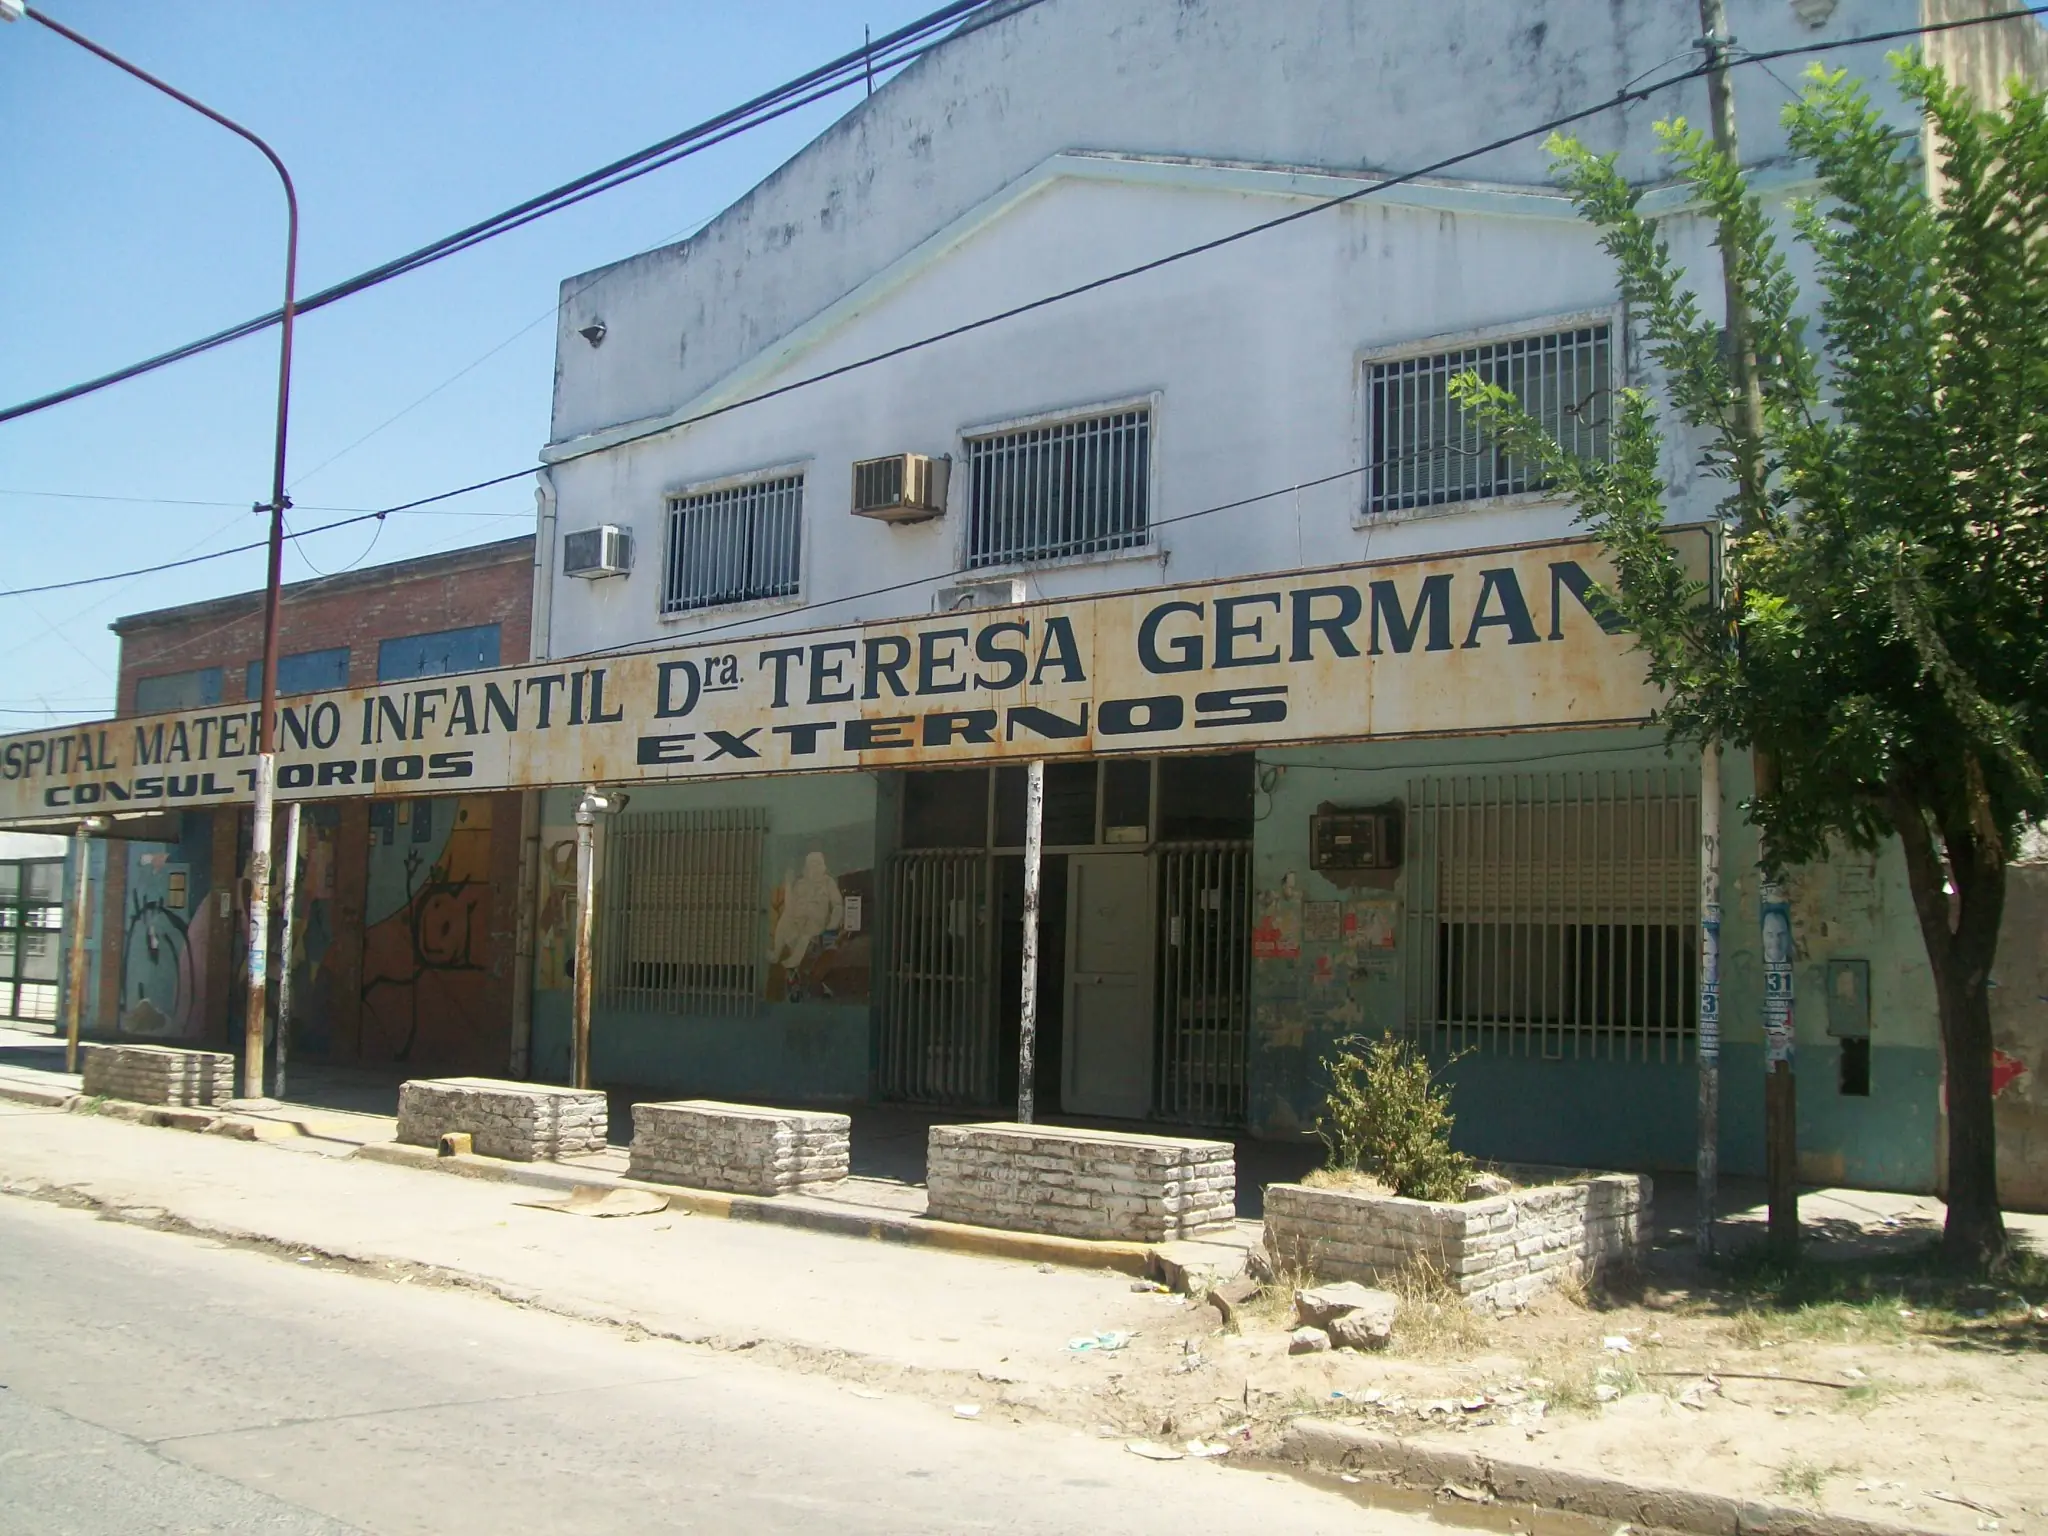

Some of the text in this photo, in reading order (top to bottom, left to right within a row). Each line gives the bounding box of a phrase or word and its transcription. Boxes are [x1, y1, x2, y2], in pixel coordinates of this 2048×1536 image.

[0, 731, 117, 781] SPITAL
[360, 669, 624, 746] INFANTIL
[653, 652, 744, 720] Dra.
[758, 616, 1087, 709] TERESA
[1137, 560, 1678, 675] GERMAN
[637, 685, 1289, 765] EXTERNOS
